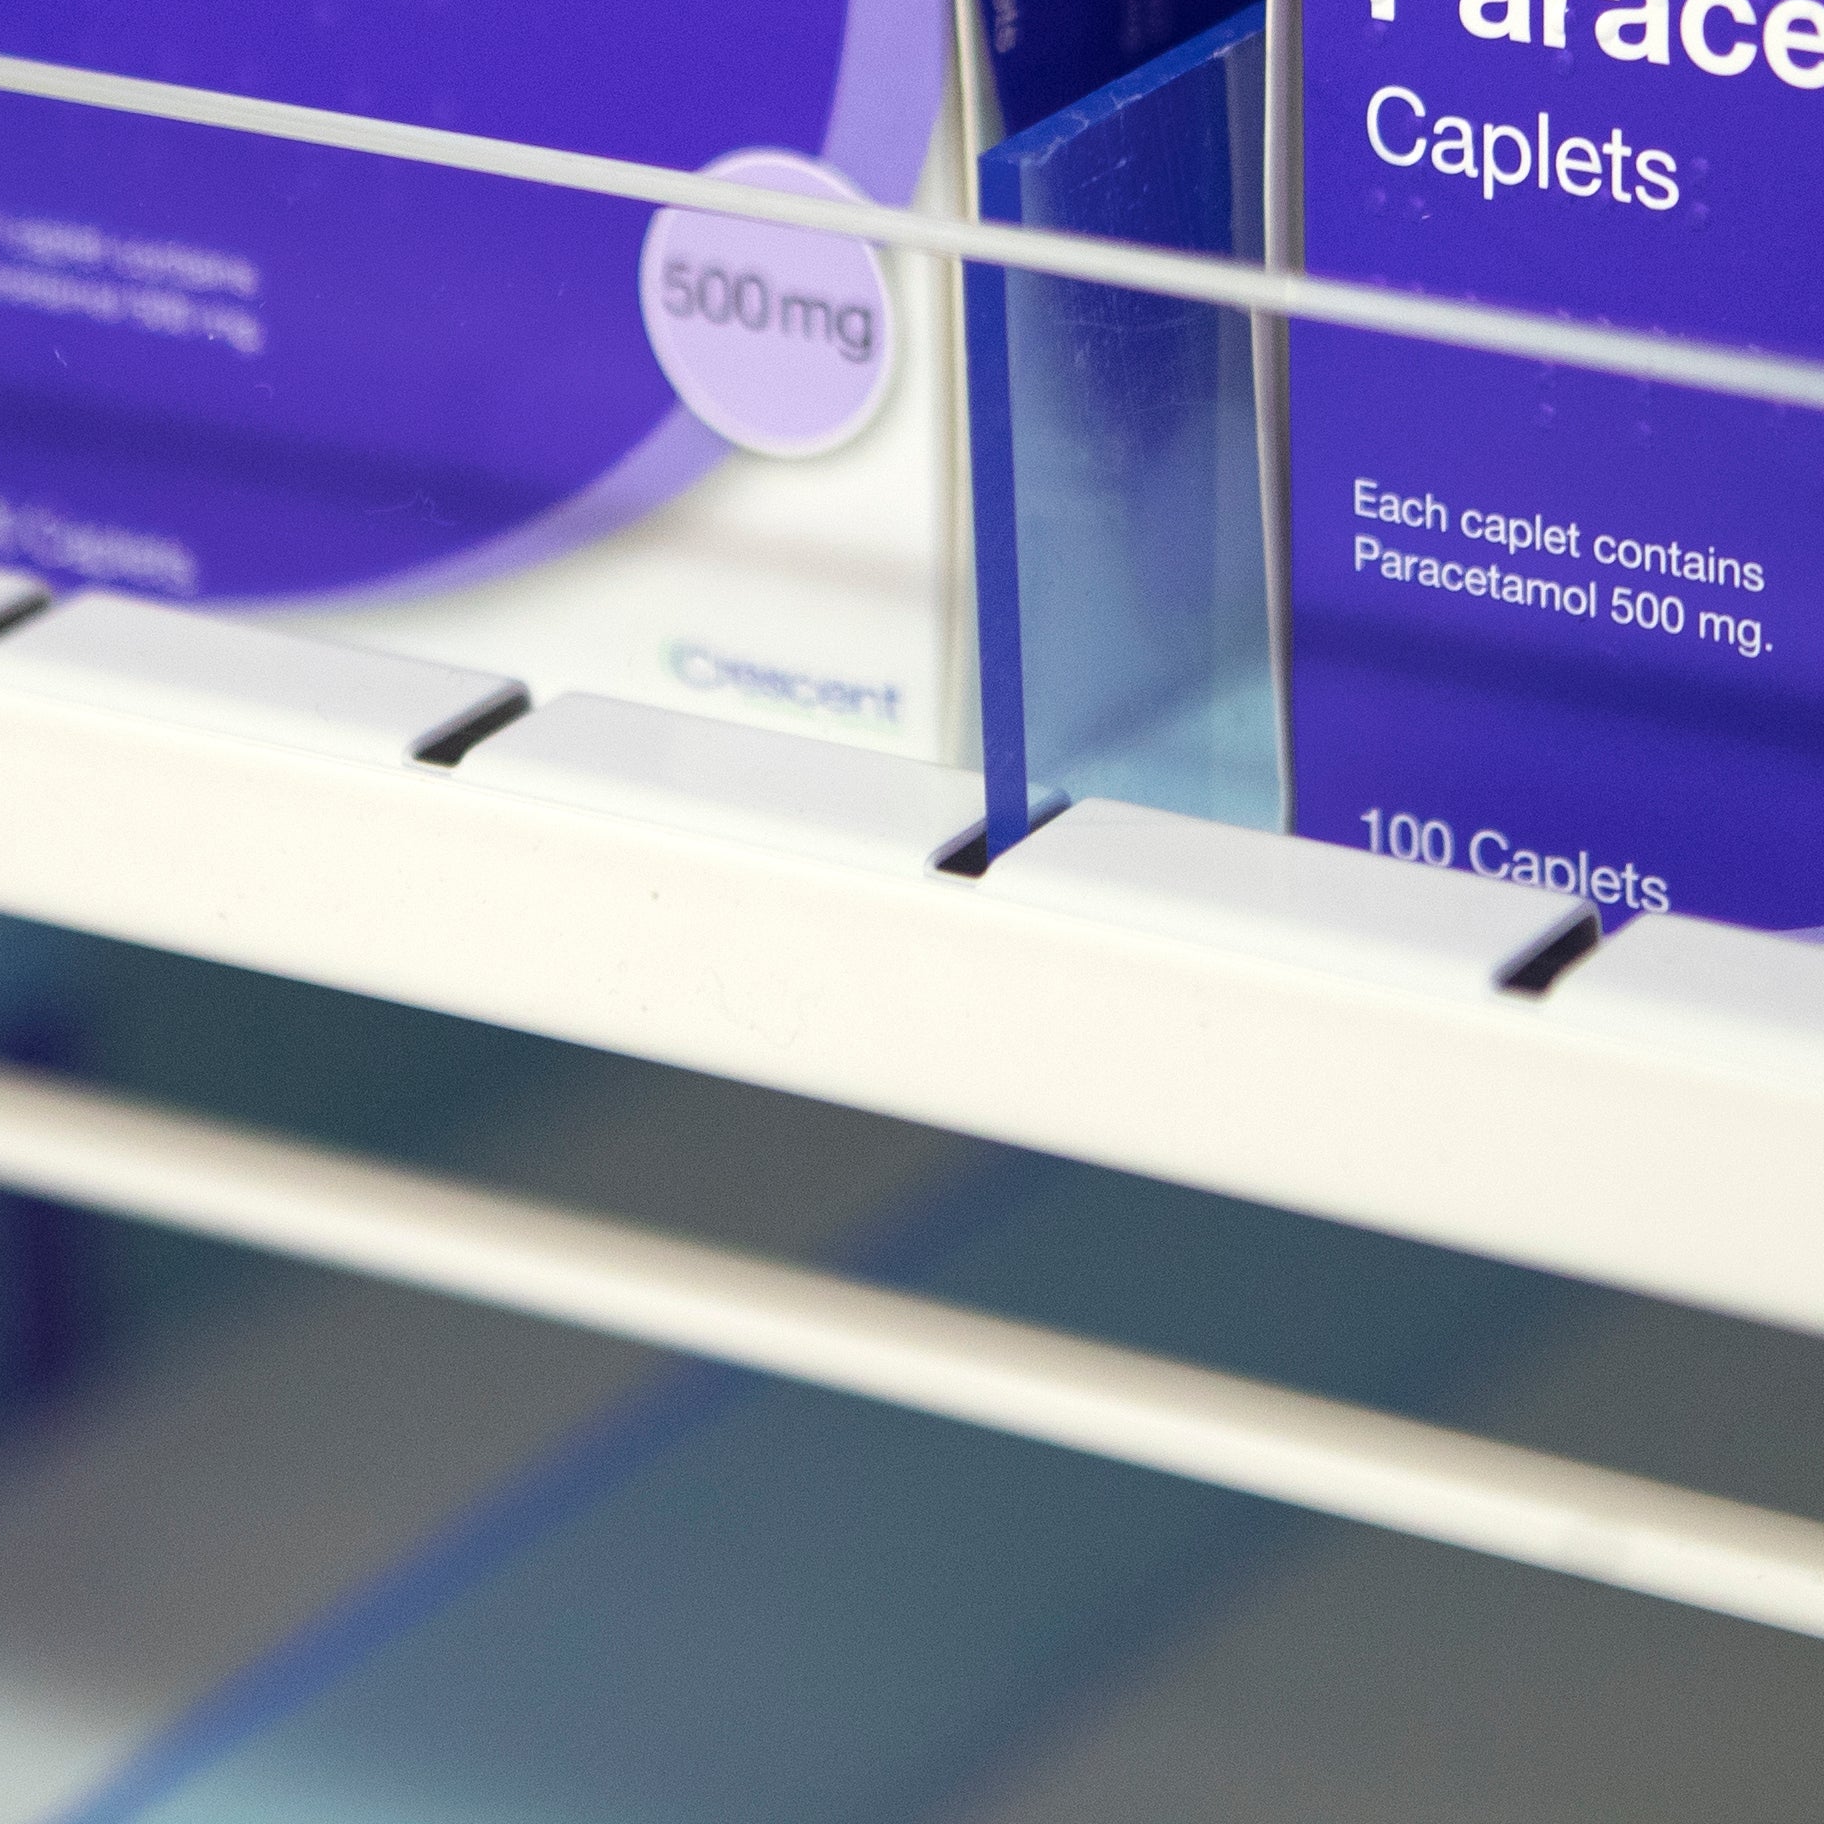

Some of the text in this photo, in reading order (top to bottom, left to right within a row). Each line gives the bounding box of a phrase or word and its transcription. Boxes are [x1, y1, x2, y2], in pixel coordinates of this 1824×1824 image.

[1366, 85, 1681, 211] Caplets
[1353, 478, 1766, 593] Each caplet contains
[1353, 536, 1775, 658] Paracetamol 500 mg.
[1359, 807, 1671, 914] 100 Caplets
